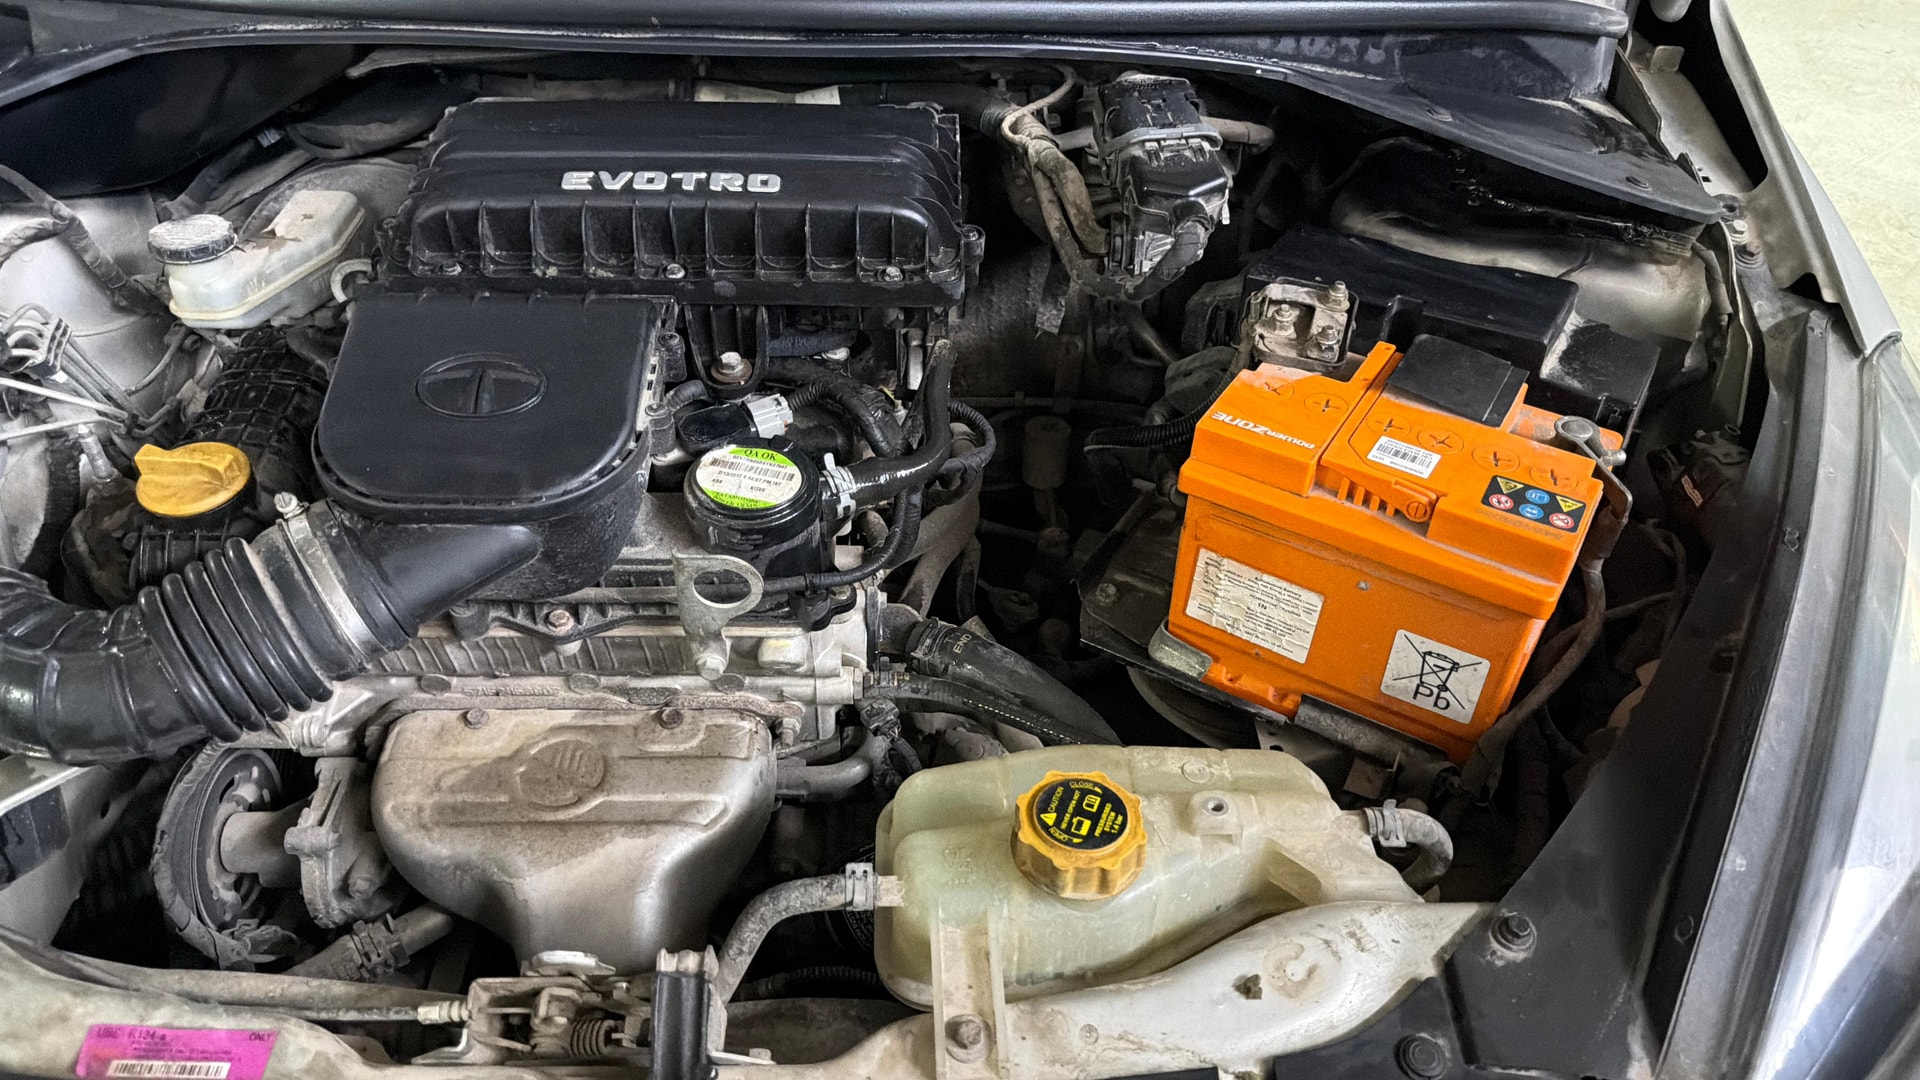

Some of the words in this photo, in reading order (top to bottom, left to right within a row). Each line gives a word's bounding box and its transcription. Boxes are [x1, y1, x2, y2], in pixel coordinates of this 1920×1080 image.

[561, 171, 781, 192] EVOTRO
[1211, 411, 1315, 449] POWERZONE
[744, 449, 758, 458] QA
[761, 452, 777, 461] OK
[953, 633, 972, 654] END
[1412, 683, 1450, 710] Pb
[1048, 786, 1064, 812] CAUTION
[1061, 811, 1072, 830] NEVER
[1104, 811, 1116, 832] SYSTEM
[249, 1032, 271, 1042] ONLY
